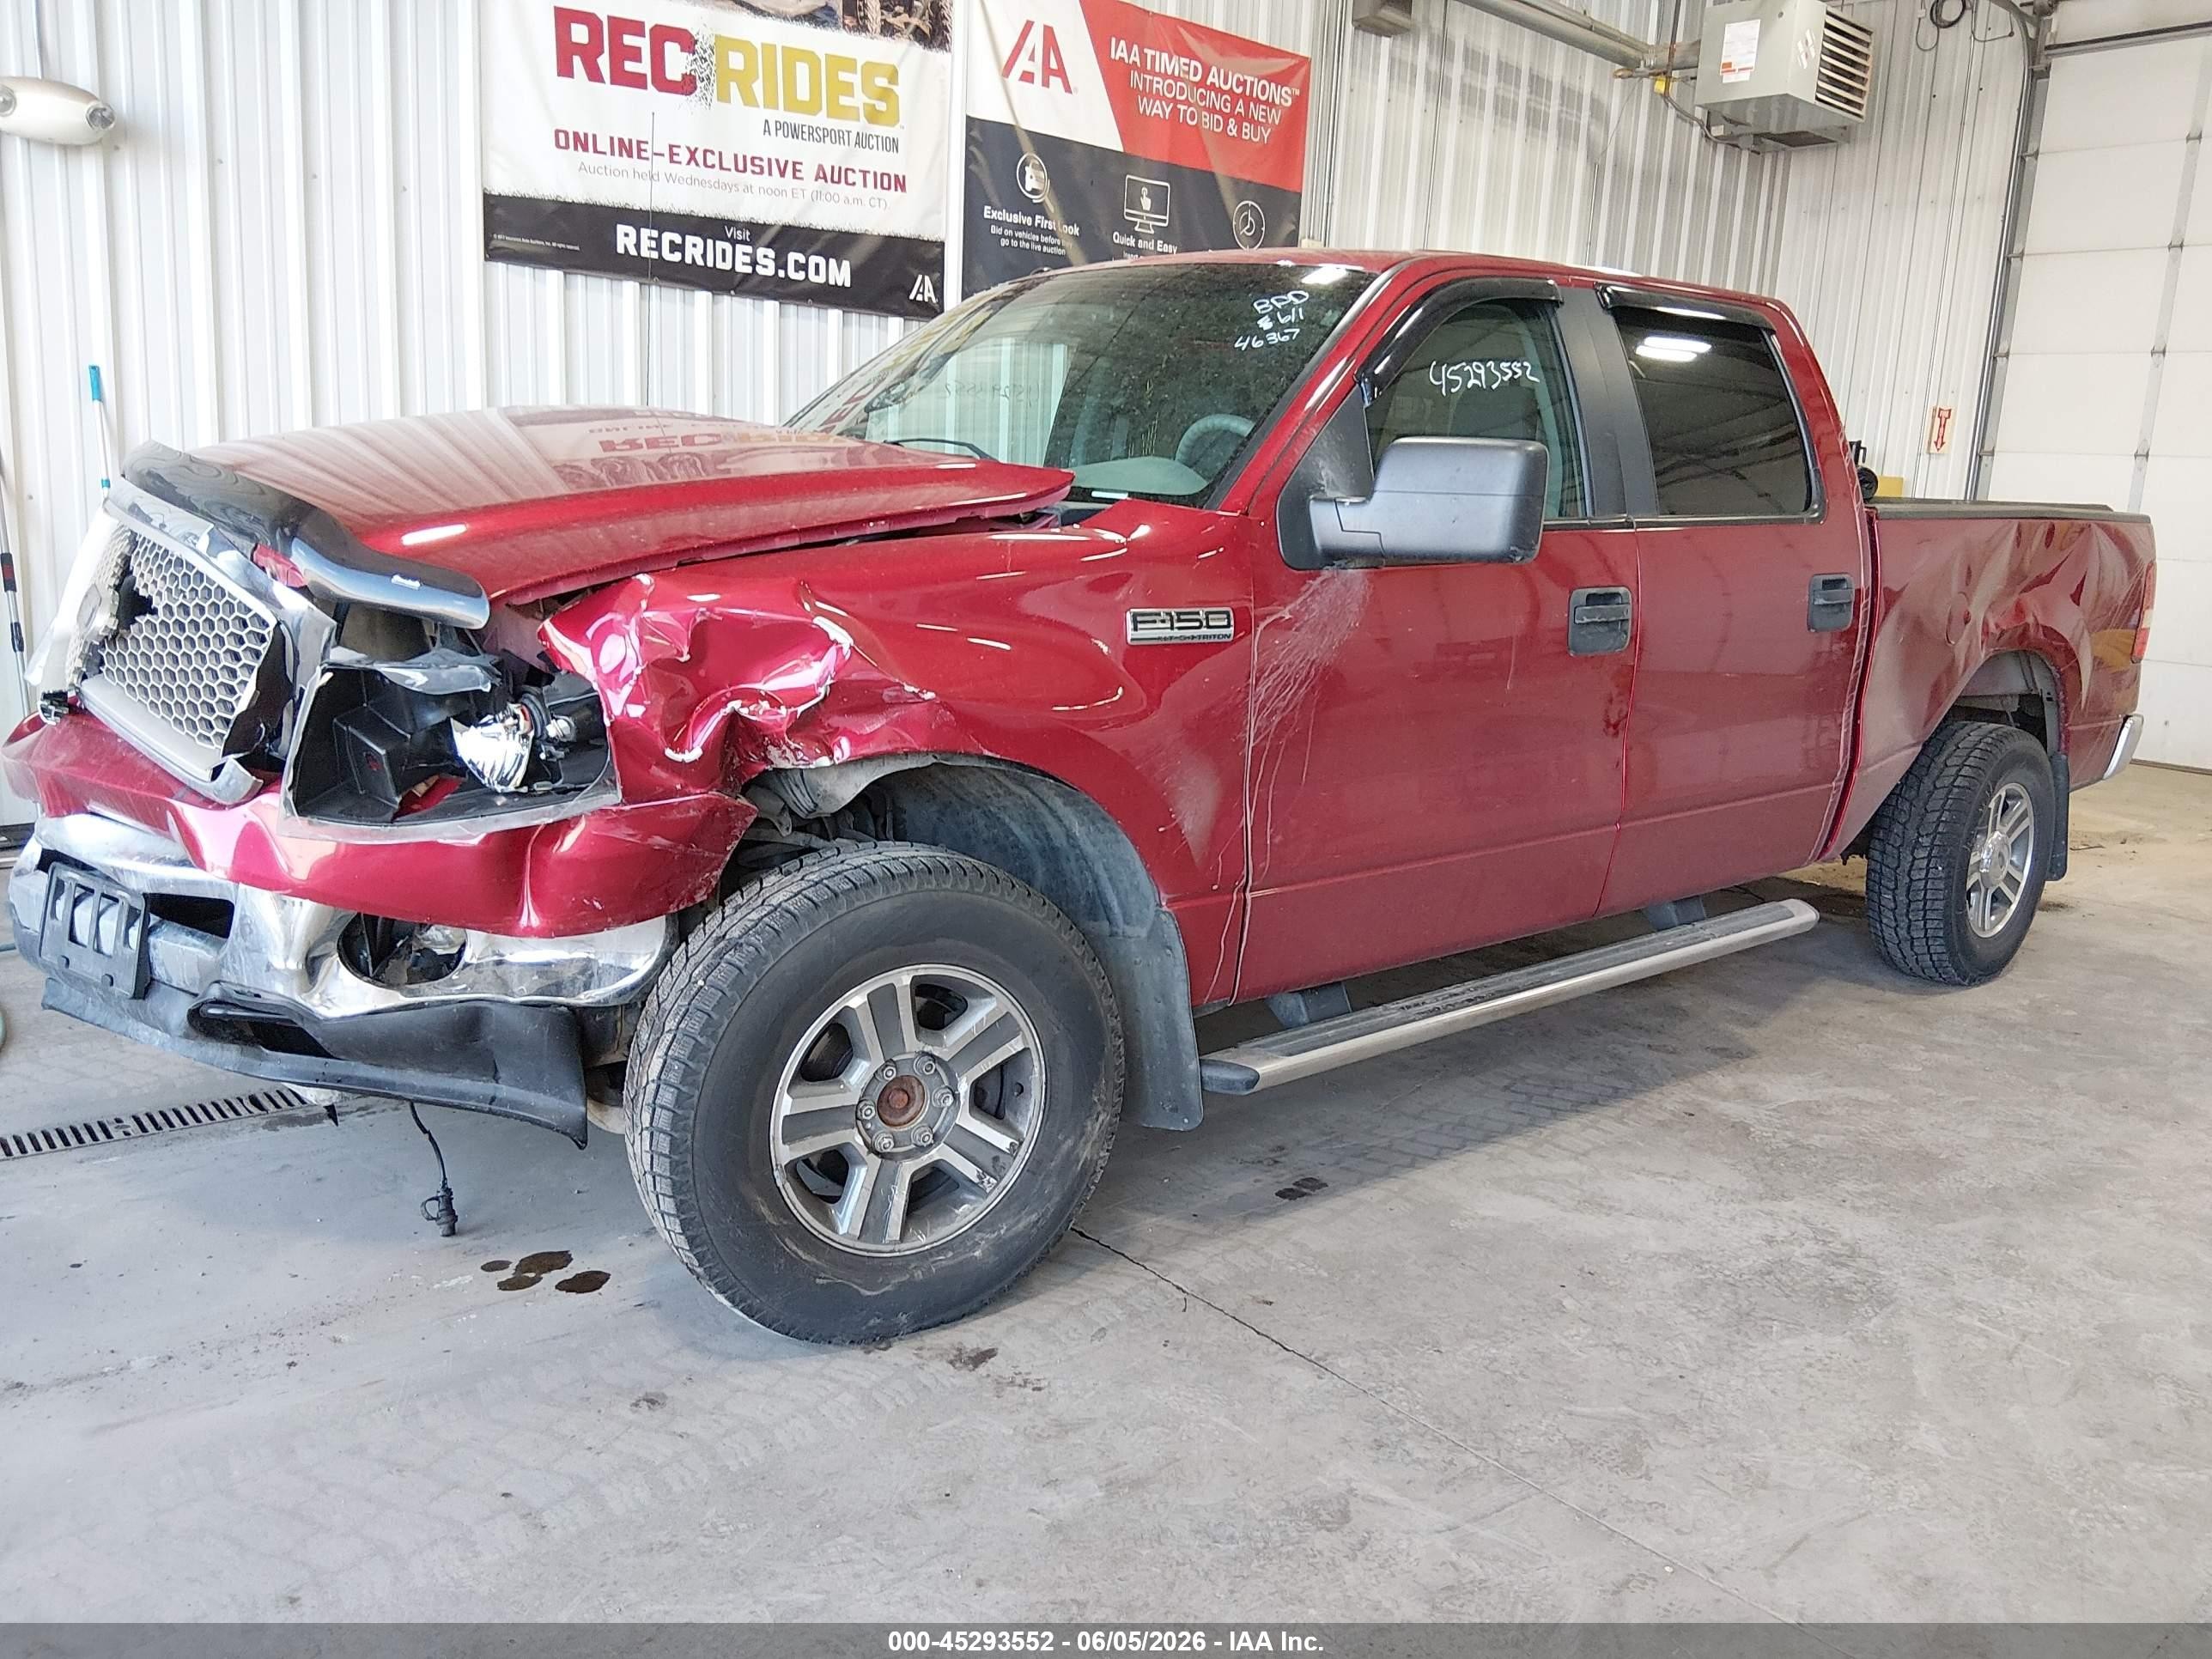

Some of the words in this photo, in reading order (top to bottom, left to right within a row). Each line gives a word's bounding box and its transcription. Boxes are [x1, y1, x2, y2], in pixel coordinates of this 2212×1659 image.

[554, 6, 697, 96] REC
[714, 33, 900, 128] RIDES
[1109, 36, 1141, 68] IAA
[1144, 48, 1202, 83] TIMED
[1130, 70, 1231, 112] INTRODUCING
[1235, 99, 1245, 116] A
[1249, 102, 1282, 125] NEW
[763, 118, 772, 137] A
[775, 120, 852, 148] POWERSPORT
[854, 131, 900, 155] AUCTION
[1138, 94, 1174, 120] WAY
[1177, 104, 1198, 125] TO
[1201, 112, 1224, 133] BID
[1226, 118, 1238, 138] &
[1242, 122, 1272, 144] BUY
[554, 129, 805, 181] ONLINE-EXCLUSIVE
[814, 163, 908, 193] AUCTION
[578, 161, 629, 178] Auction
[633, 167, 660, 182] held
[665, 172, 740, 193] Wednesdays
[743, 183, 755, 194] at
[758, 185, 787, 199] noon
[792, 188, 807, 199] ET
[724, 225, 751, 242] Visit
[983, 205, 1033, 227] Exclusive
[1034, 214, 1056, 232] First
[1004, 228, 1013, 237] on
[1015, 229, 1040, 242] vehicles
[616, 224, 851, 289] RECRIDES.COM
[1011, 238, 1018, 247] to
[1019, 239, 1030, 249] the
[1042, 245, 1066, 256] auction
[1112, 231, 1136, 248] Quick
[1138, 239, 1155, 251] and
[1157, 240, 1178, 255] Easy
[1234, 328, 1300, 351] 46367
[1429, 361, 1540, 397] 45293552
